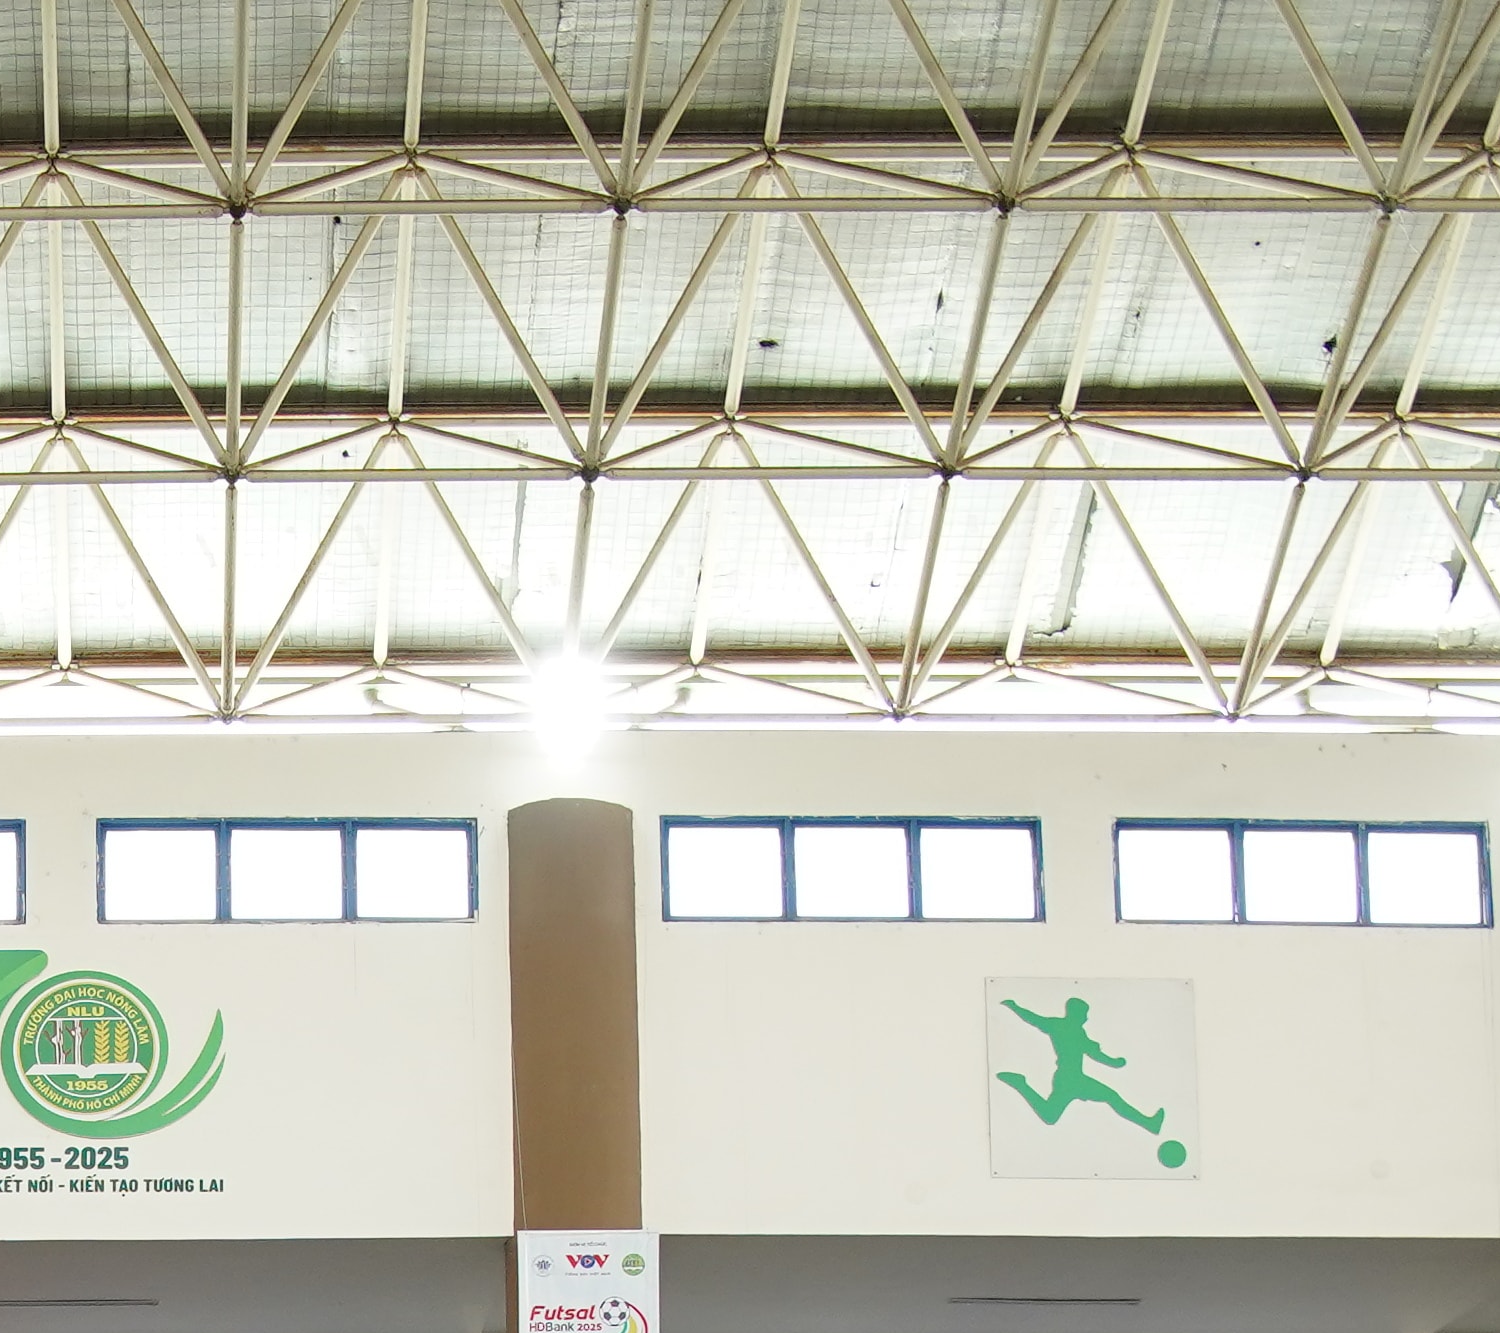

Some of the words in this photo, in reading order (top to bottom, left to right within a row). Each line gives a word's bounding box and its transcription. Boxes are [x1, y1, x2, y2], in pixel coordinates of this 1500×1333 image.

[24, 1002, 54, 1045] TRƯỜNG
[55, 988, 75, 1004] ĐẠI
[79, 988, 105, 999] HỌC
[107, 992, 137, 1019] NÔNG
[134, 1018, 149, 1045] LÂM
[67, 1007, 104, 1016] NLU
[33, 1077, 63, 1103] THÀNH
[63, 1098, 84, 1110] PHỐ
[86, 1098, 102, 1110] HỒ
[104, 1094, 120, 1106] CHÍ
[118, 1075, 142, 1097] MINH
[67, 1080, 108, 1091] 1955
[28, 1174, 53, 1193] NỐI
[70, 1174, 105, 1193] KIẾN
[110, 1179, 138, 1197] TẠO
[145, 1177, 194, 1193] TƯƠNG
[199, 1180, 224, 1193] LAI
[566, 1254, 610, 1268] VOV
[530, 1305, 595, 1320] Futsal
[530, 1322, 574, 1332] HDBank
[577, 1323, 602, 1331] 2025
